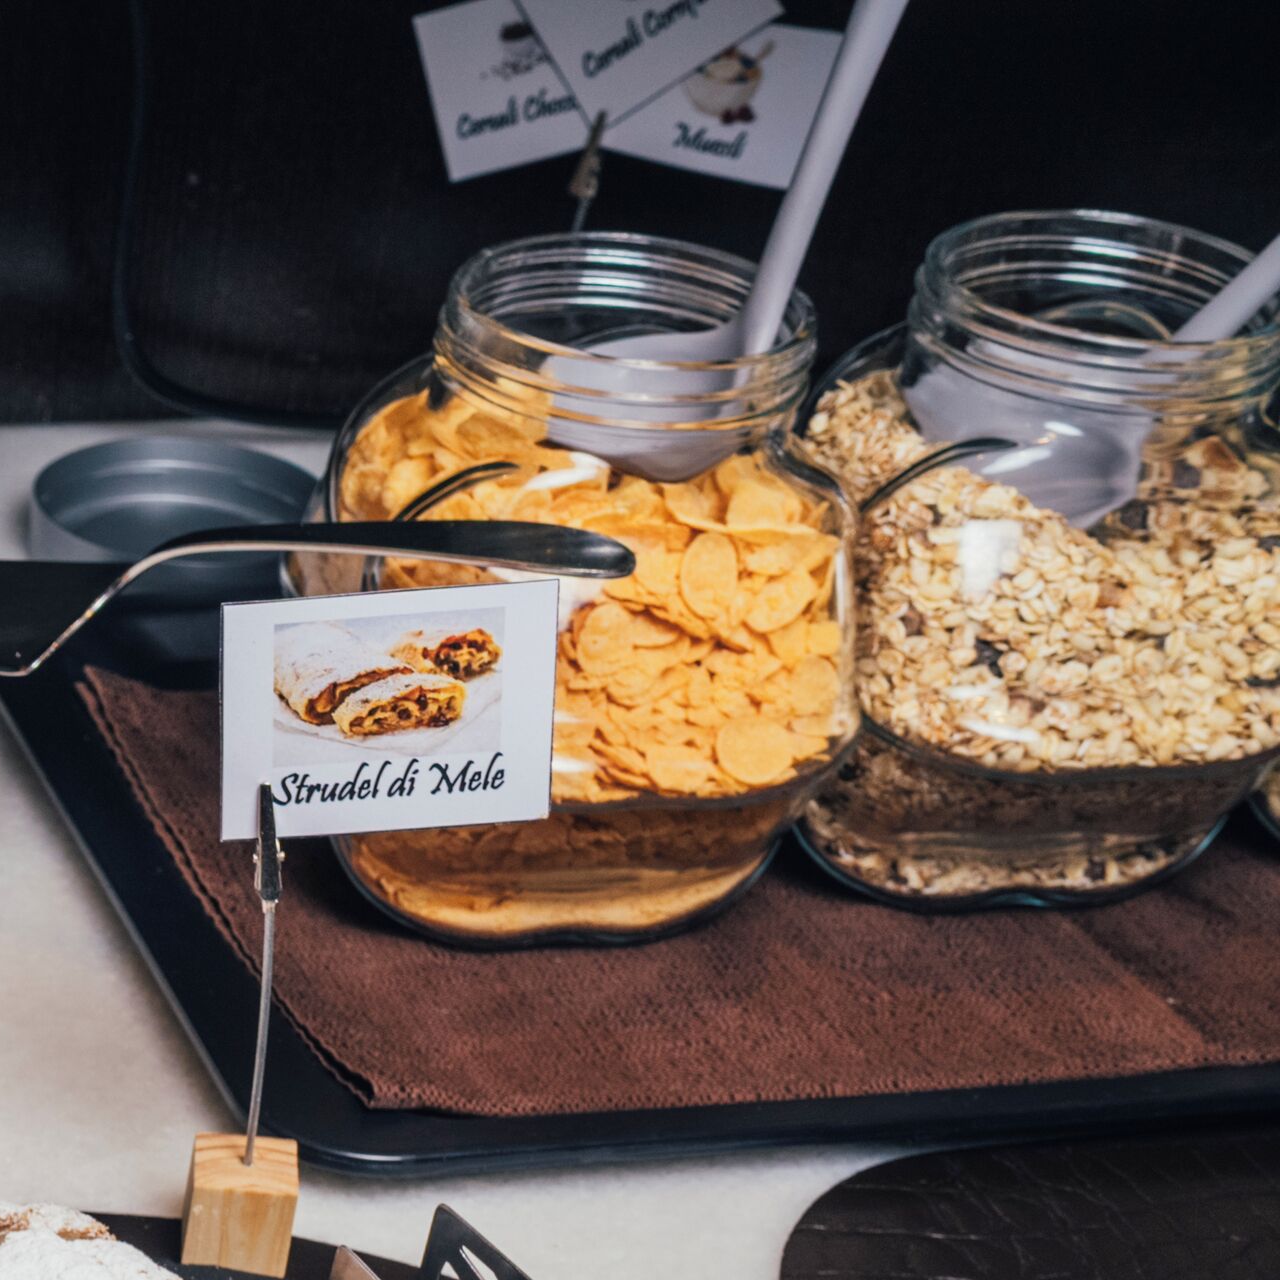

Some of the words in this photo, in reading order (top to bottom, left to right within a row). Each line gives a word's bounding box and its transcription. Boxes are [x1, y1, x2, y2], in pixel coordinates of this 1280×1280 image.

[271, 760, 392, 806] Strudel
[387, 758, 419, 797] di
[429, 752, 506, 795] Mele
